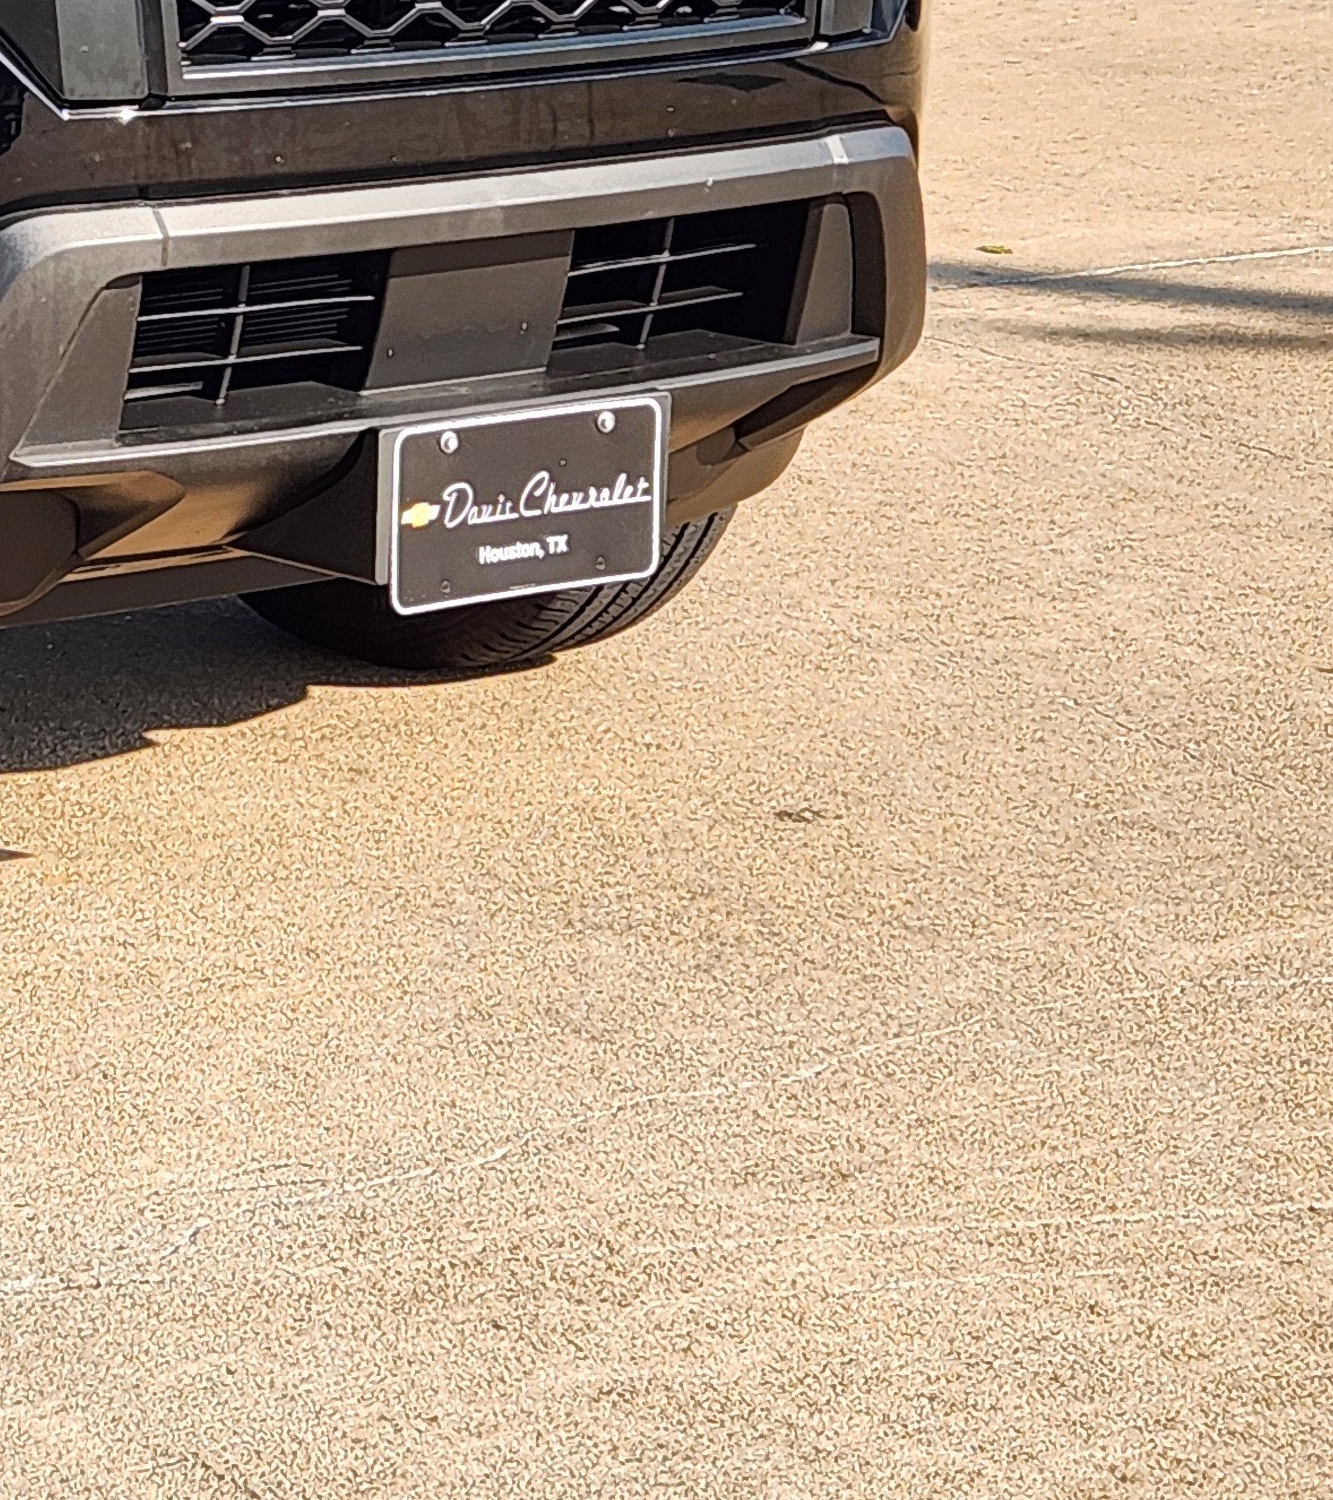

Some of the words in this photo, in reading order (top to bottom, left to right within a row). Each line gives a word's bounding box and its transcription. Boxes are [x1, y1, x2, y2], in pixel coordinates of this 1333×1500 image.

[442, 481, 519, 529] Davis
[519, 470, 652, 518] Chevrolet
[478, 540, 545, 565] Houston,
[545, 533, 569, 555] TX
